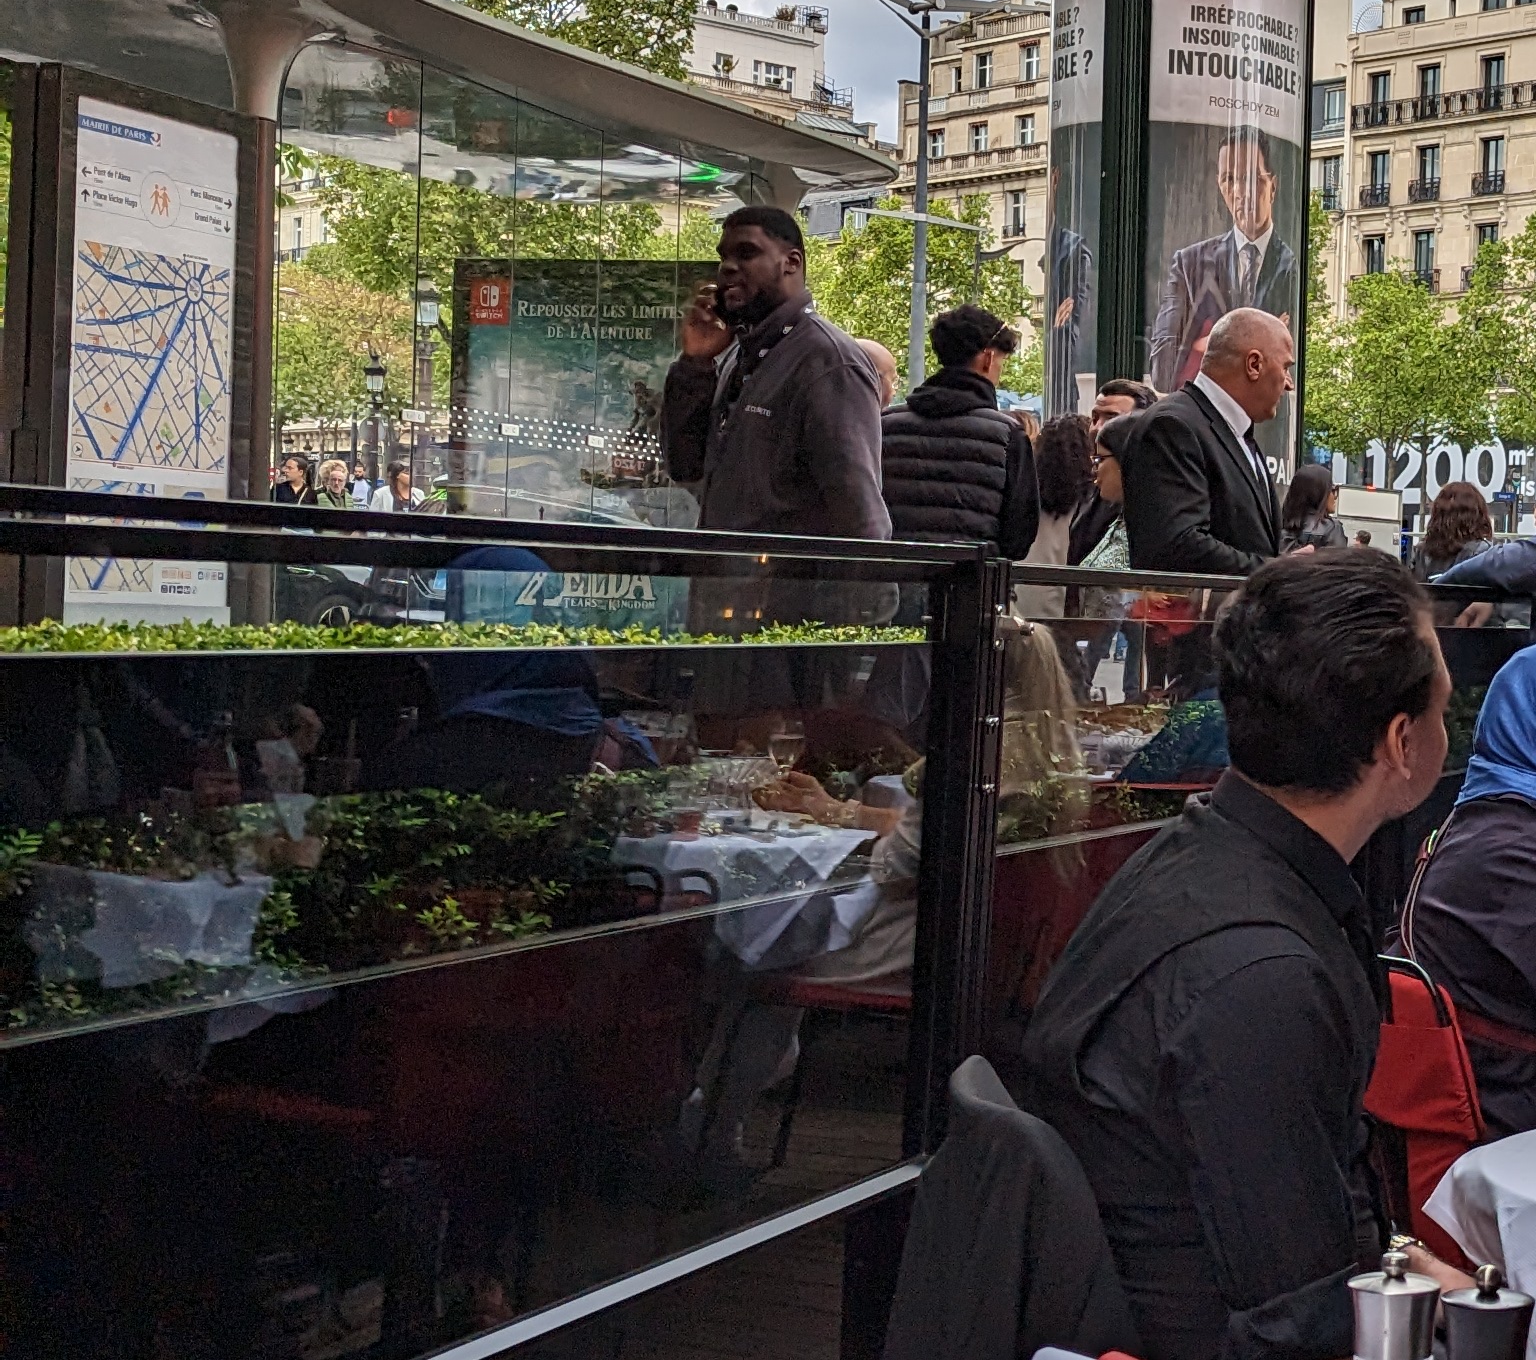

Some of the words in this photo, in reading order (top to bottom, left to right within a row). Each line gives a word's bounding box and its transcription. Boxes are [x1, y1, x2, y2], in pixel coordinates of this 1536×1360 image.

[1191, 4, 1293, 41] IRRÉPROCHABLE
[1183, 27, 1295, 64] INSOUPÇONNABLE
[1083, 49, 1093, 74] ?
[1168, 49, 1296, 95] INTOUCHABLE
[1209, 96, 1263, 113] ROSCHDY
[1265, 105, 1279, 118] ZEM
[81, 118, 109, 132] MAIRIE
[112, 125, 123, 135] DE
[124, 127, 147, 140] PARIS
[1366, 436, 1506, 504] 1200
[564, 597, 597, 609] TEARS
